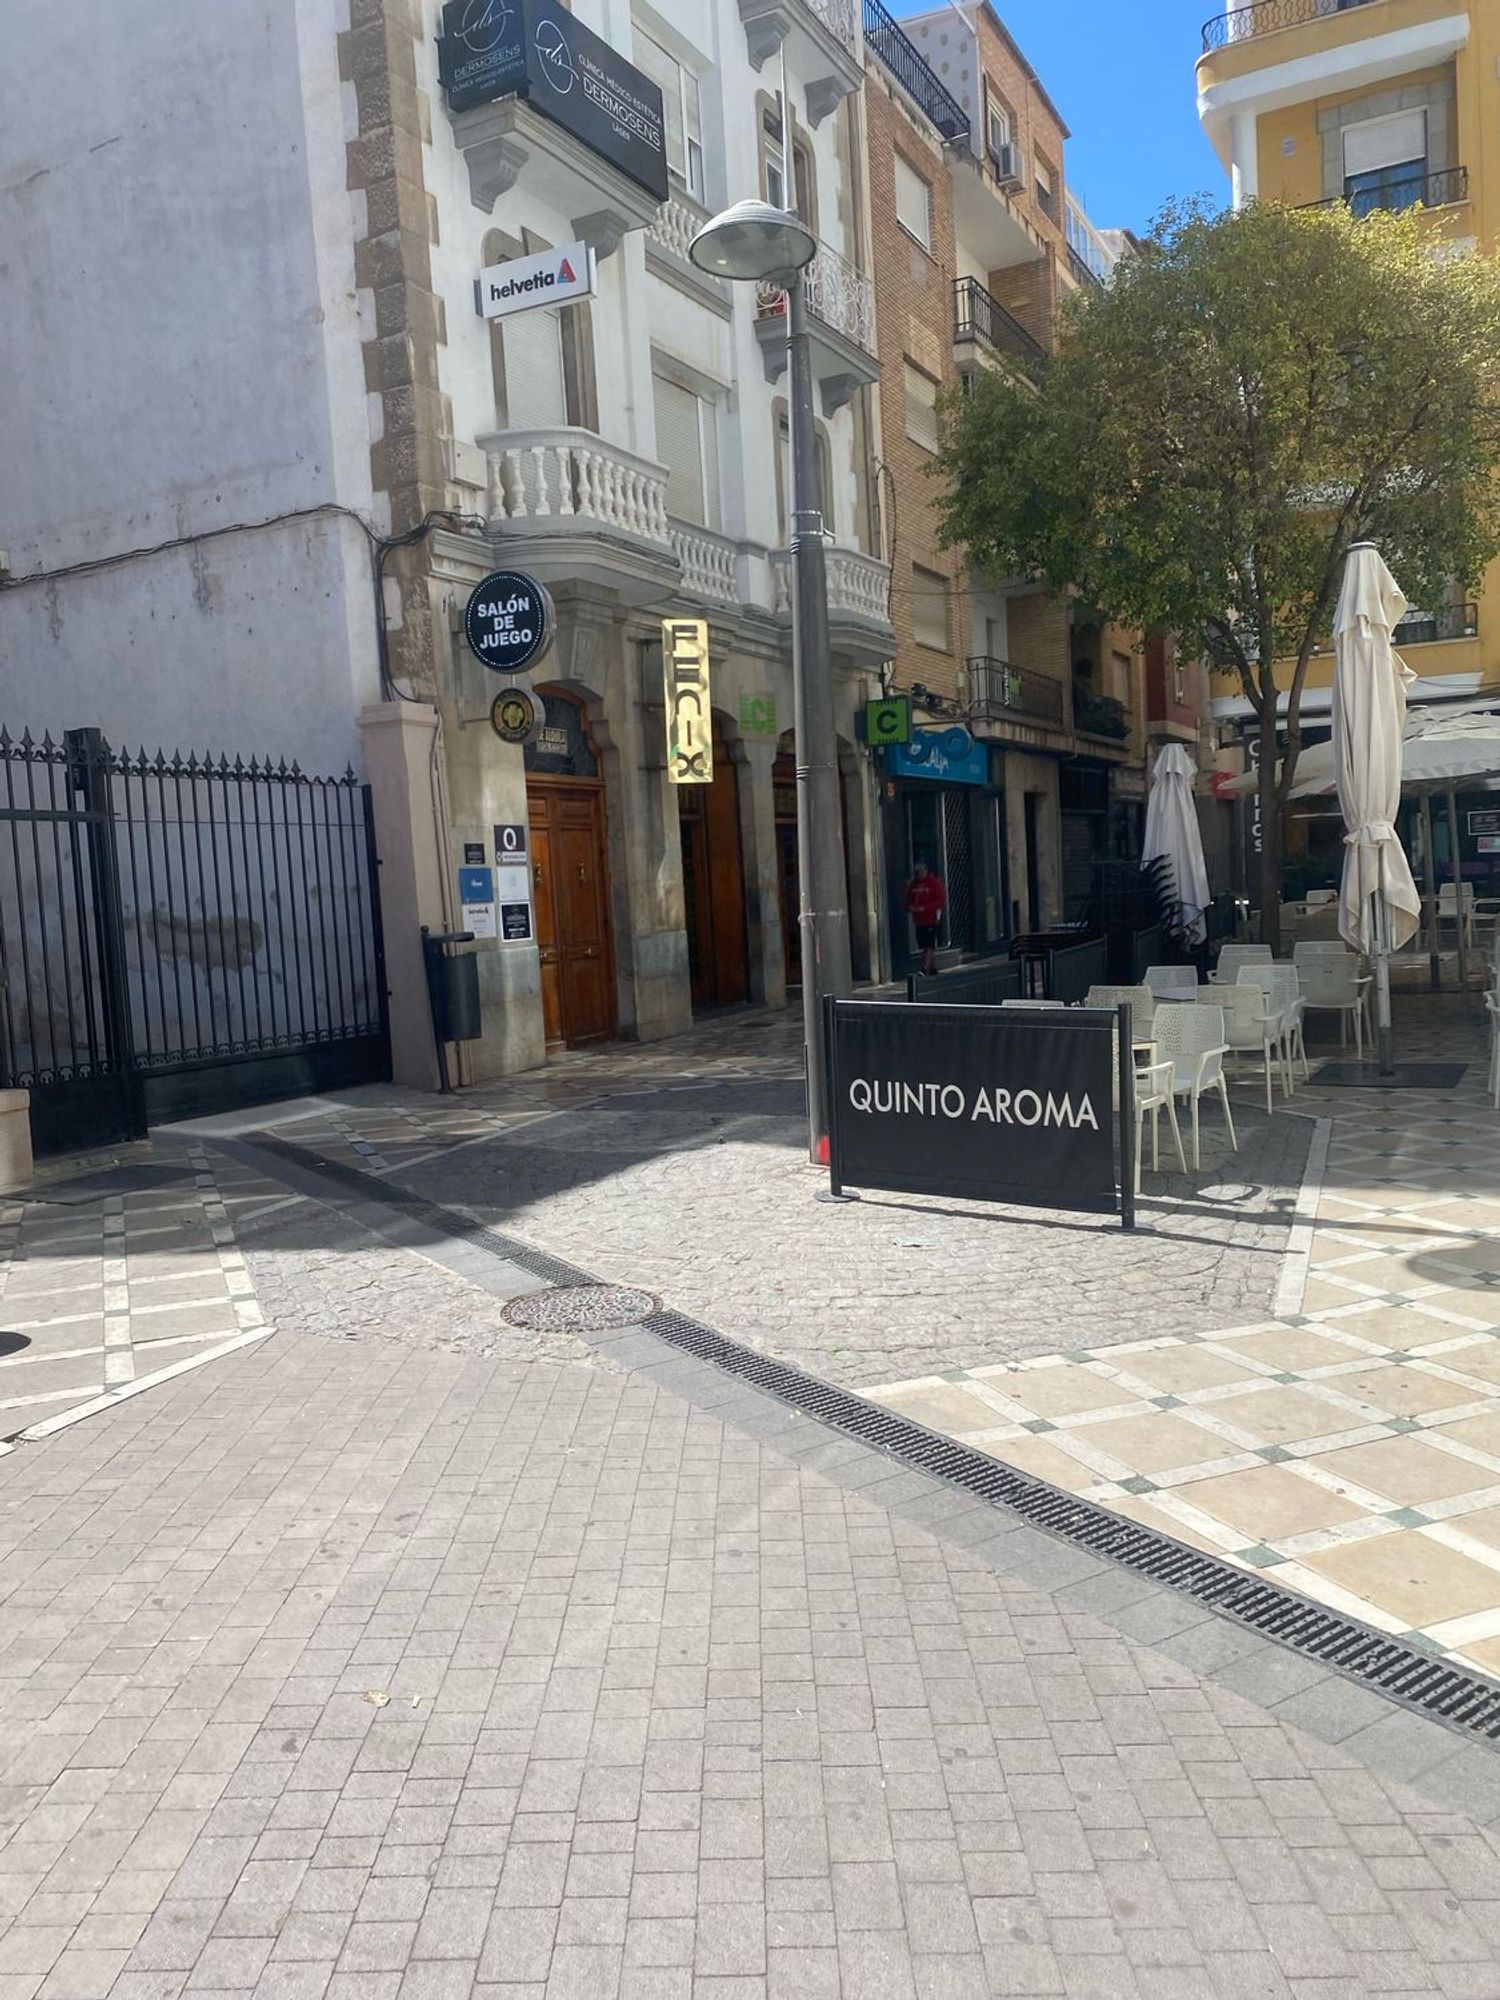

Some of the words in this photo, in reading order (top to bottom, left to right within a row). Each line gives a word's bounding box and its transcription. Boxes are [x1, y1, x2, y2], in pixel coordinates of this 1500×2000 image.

[454, 45, 521, 79] DERMOSENS
[583, 77, 661, 147] DERMOSENS
[490, 271, 555, 301] helvetia
[478, 594, 530, 618] SALÓN
[493, 615, 515, 631] DE
[480, 629, 533, 650] JUEGO
[876, 709, 899, 734] C
[849, 1078, 965, 1118] QUINTO
[970, 1086, 1100, 1131] AROMA
